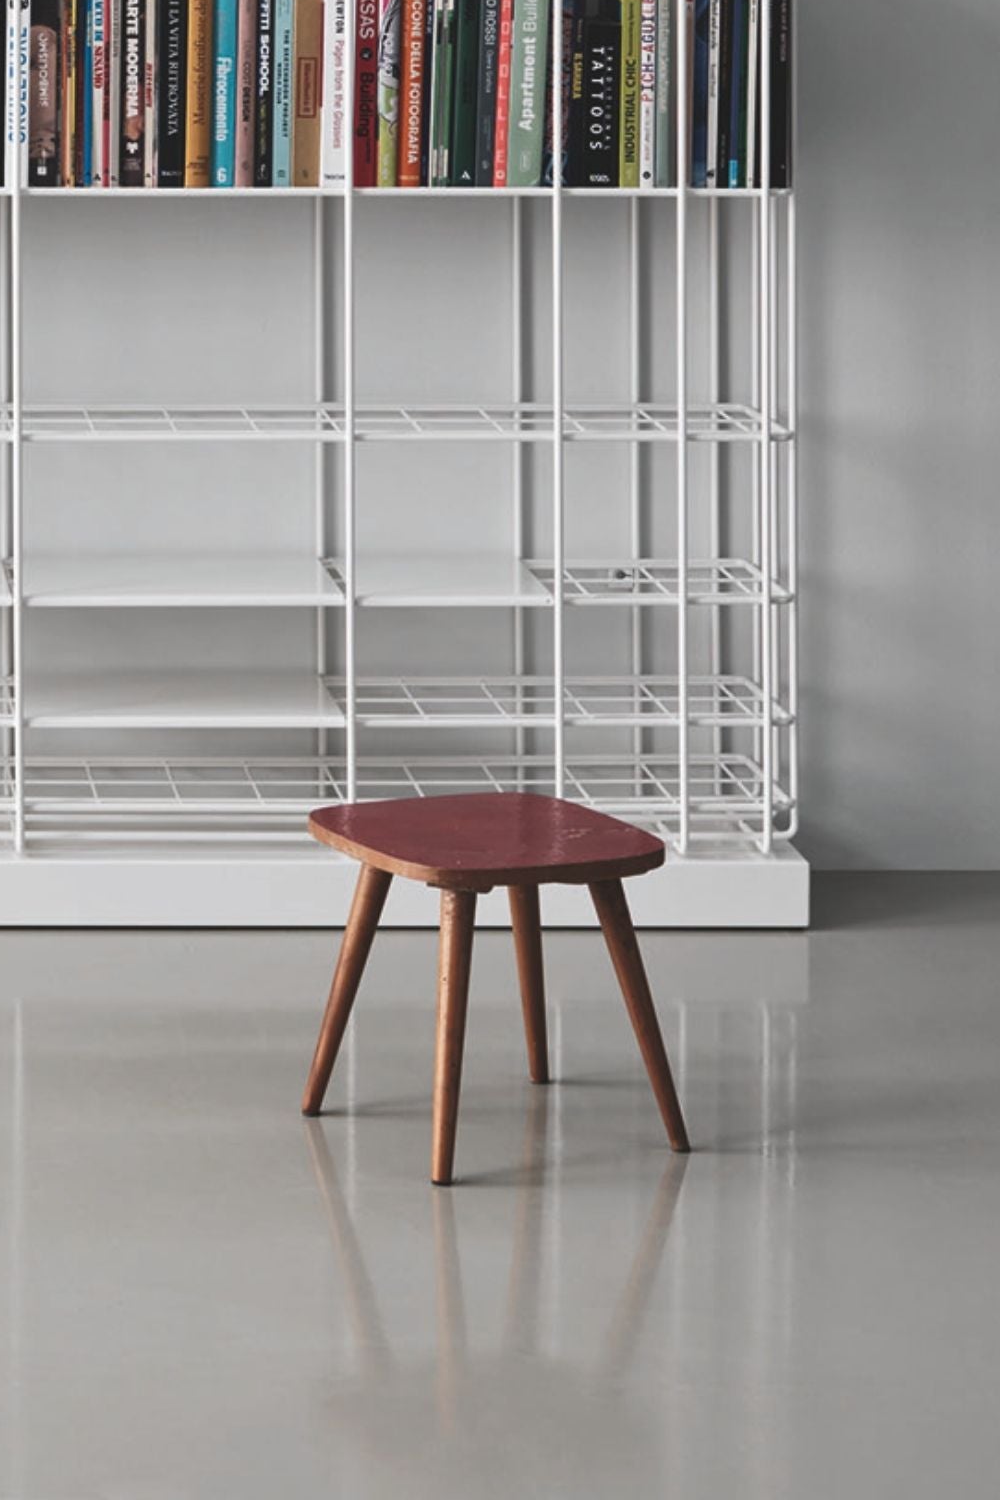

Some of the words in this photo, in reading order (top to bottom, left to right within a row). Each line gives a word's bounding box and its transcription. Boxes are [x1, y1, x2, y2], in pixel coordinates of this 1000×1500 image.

[169, 8, 180, 25] LA
[484, 10, 497, 45] ROSSI
[169, 27, 180, 58] VITA
[259, 34, 271, 96] SCHOOL
[332, 40, 345, 74] Pages
[409, 41, 421, 78] DELLA
[37, 32, 49, 107] SIMBOLISMO
[94, 46, 104, 89] SESAMO
[126, 39, 138, 117] MODERNA
[333, 76, 344, 92] from
[518, 38, 536, 131] Apartment
[624, 59, 636, 88] CHIC
[167, 61, 180, 136] RITROVATA
[193, 74, 205, 125] Masserie
[216, 57, 232, 142] Fibrocemento
[242, 86, 251, 122] DESIGN
[333, 94, 344, 109] the
[356, 71, 375, 138] Building
[590, 47, 605, 151] TATTOOS
[333, 111, 344, 149] Glossies
[407, 82, 420, 163] FOTOGRAFIA
[624, 91, 636, 163] INDUSTRIAL
